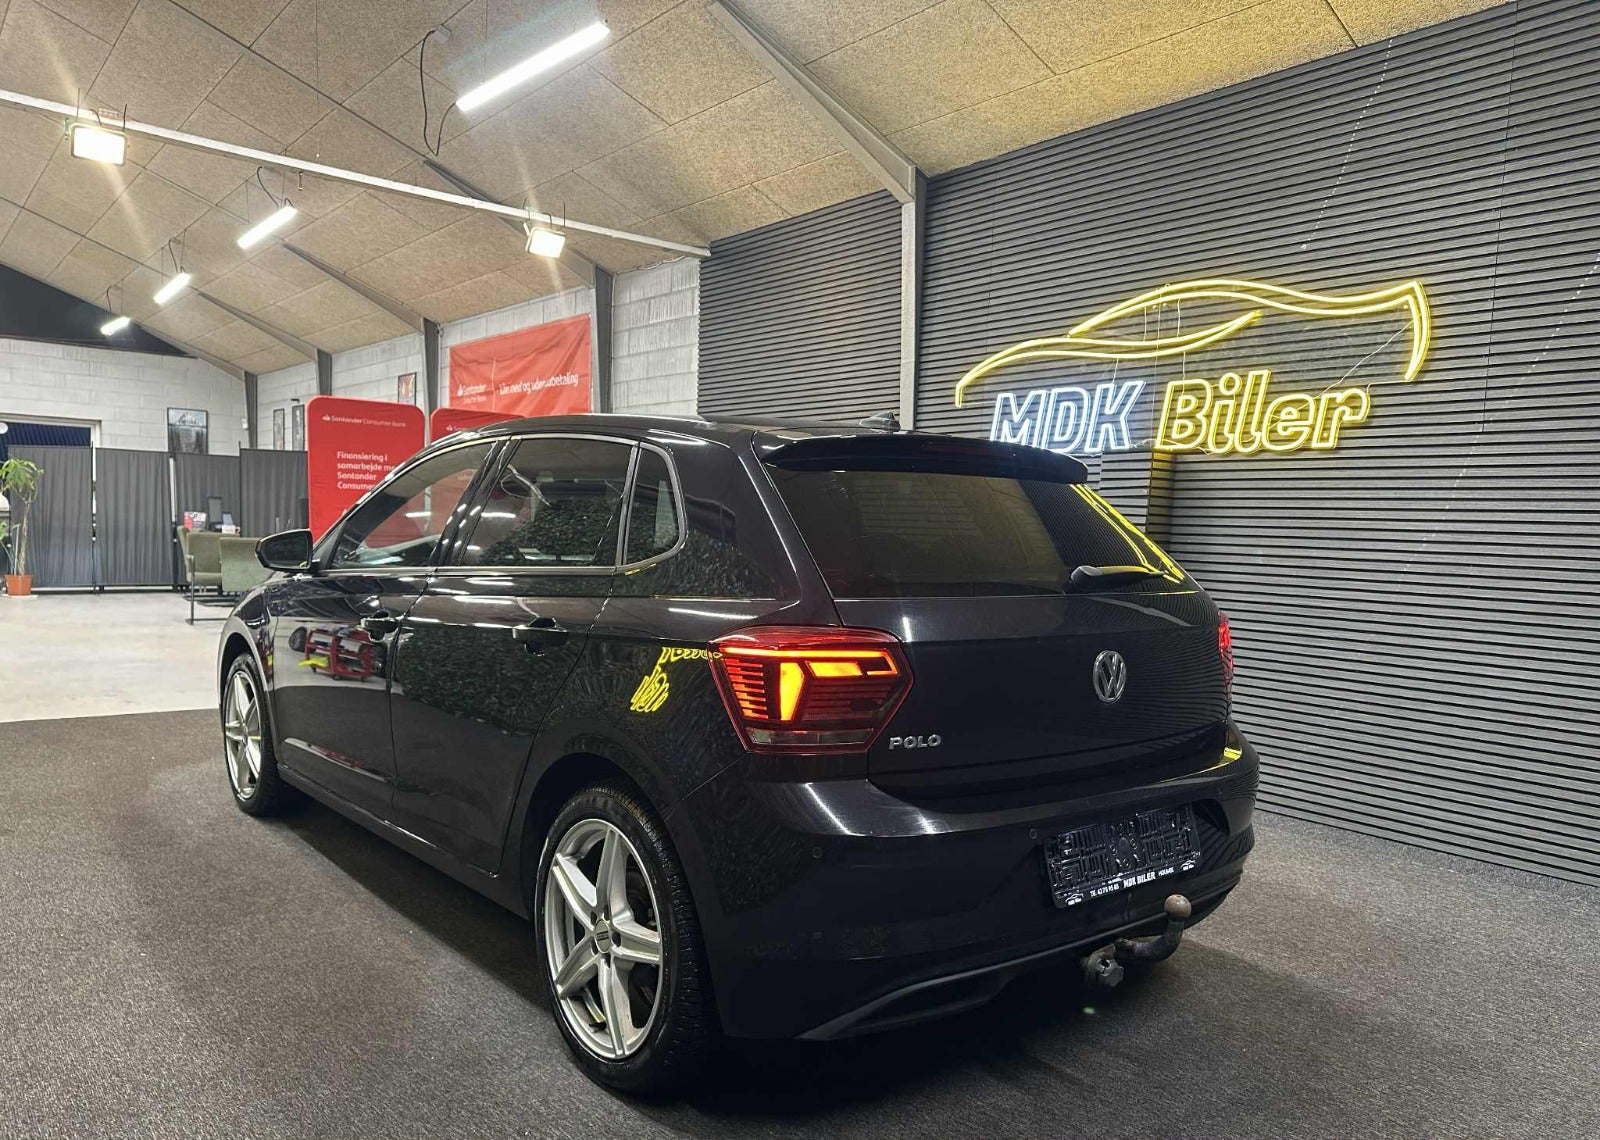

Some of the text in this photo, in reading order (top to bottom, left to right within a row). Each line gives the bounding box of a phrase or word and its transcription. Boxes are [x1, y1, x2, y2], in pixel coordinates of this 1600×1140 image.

[989, 369, 1370, 455] MDK Biler
[336, 451, 384, 462] Finansiering
[336, 462, 383, 472] samarbejde
[337, 471, 377, 481] Santander
[888, 734, 942, 750] POLO
